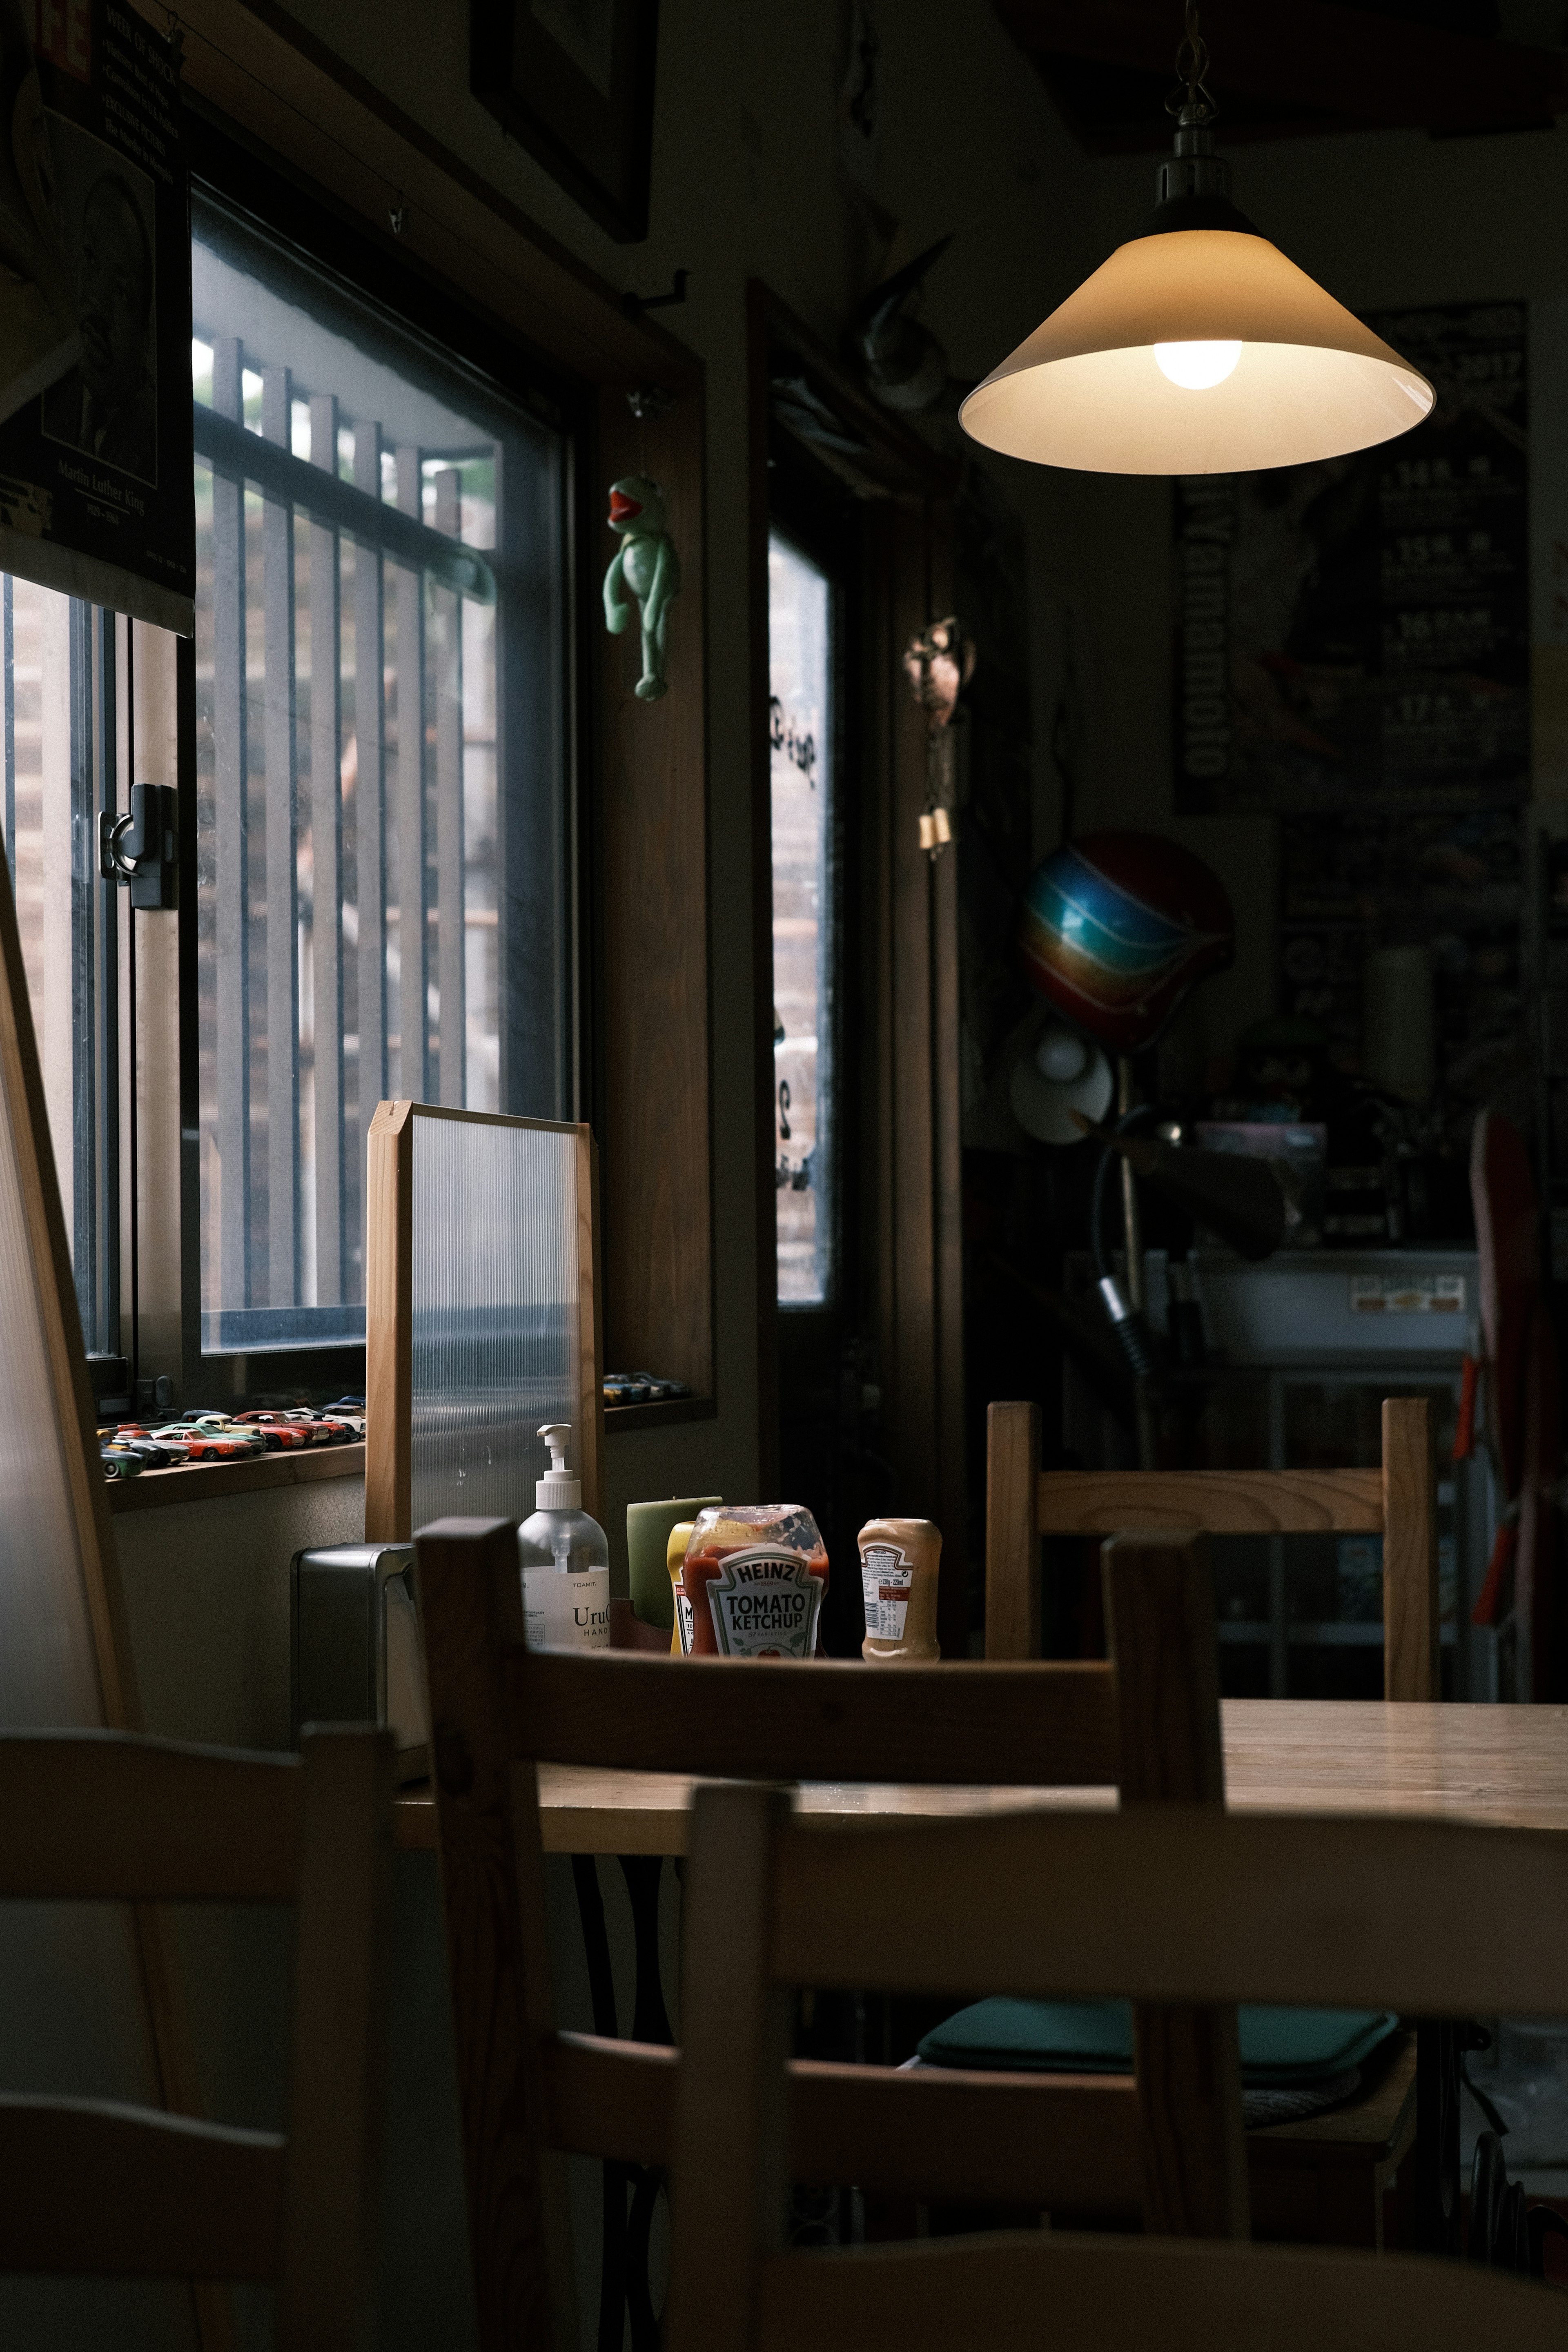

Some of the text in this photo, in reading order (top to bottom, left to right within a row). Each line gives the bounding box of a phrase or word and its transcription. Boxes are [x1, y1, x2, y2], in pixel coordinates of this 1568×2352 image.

[106, 4, 176, 87] WEEK OF SHOCK
[104, 116, 118, 137] The
[58, 458, 145, 517] Martin Luther King
[1183, 514, 1232, 776] Yamamoto
[737, 1562, 795, 1584] HEINZ
[726, 1593, 805, 1615] TOMATO
[584, 1627, 607, 1636] HAND
[732, 1613, 803, 1630] KETCHUP
